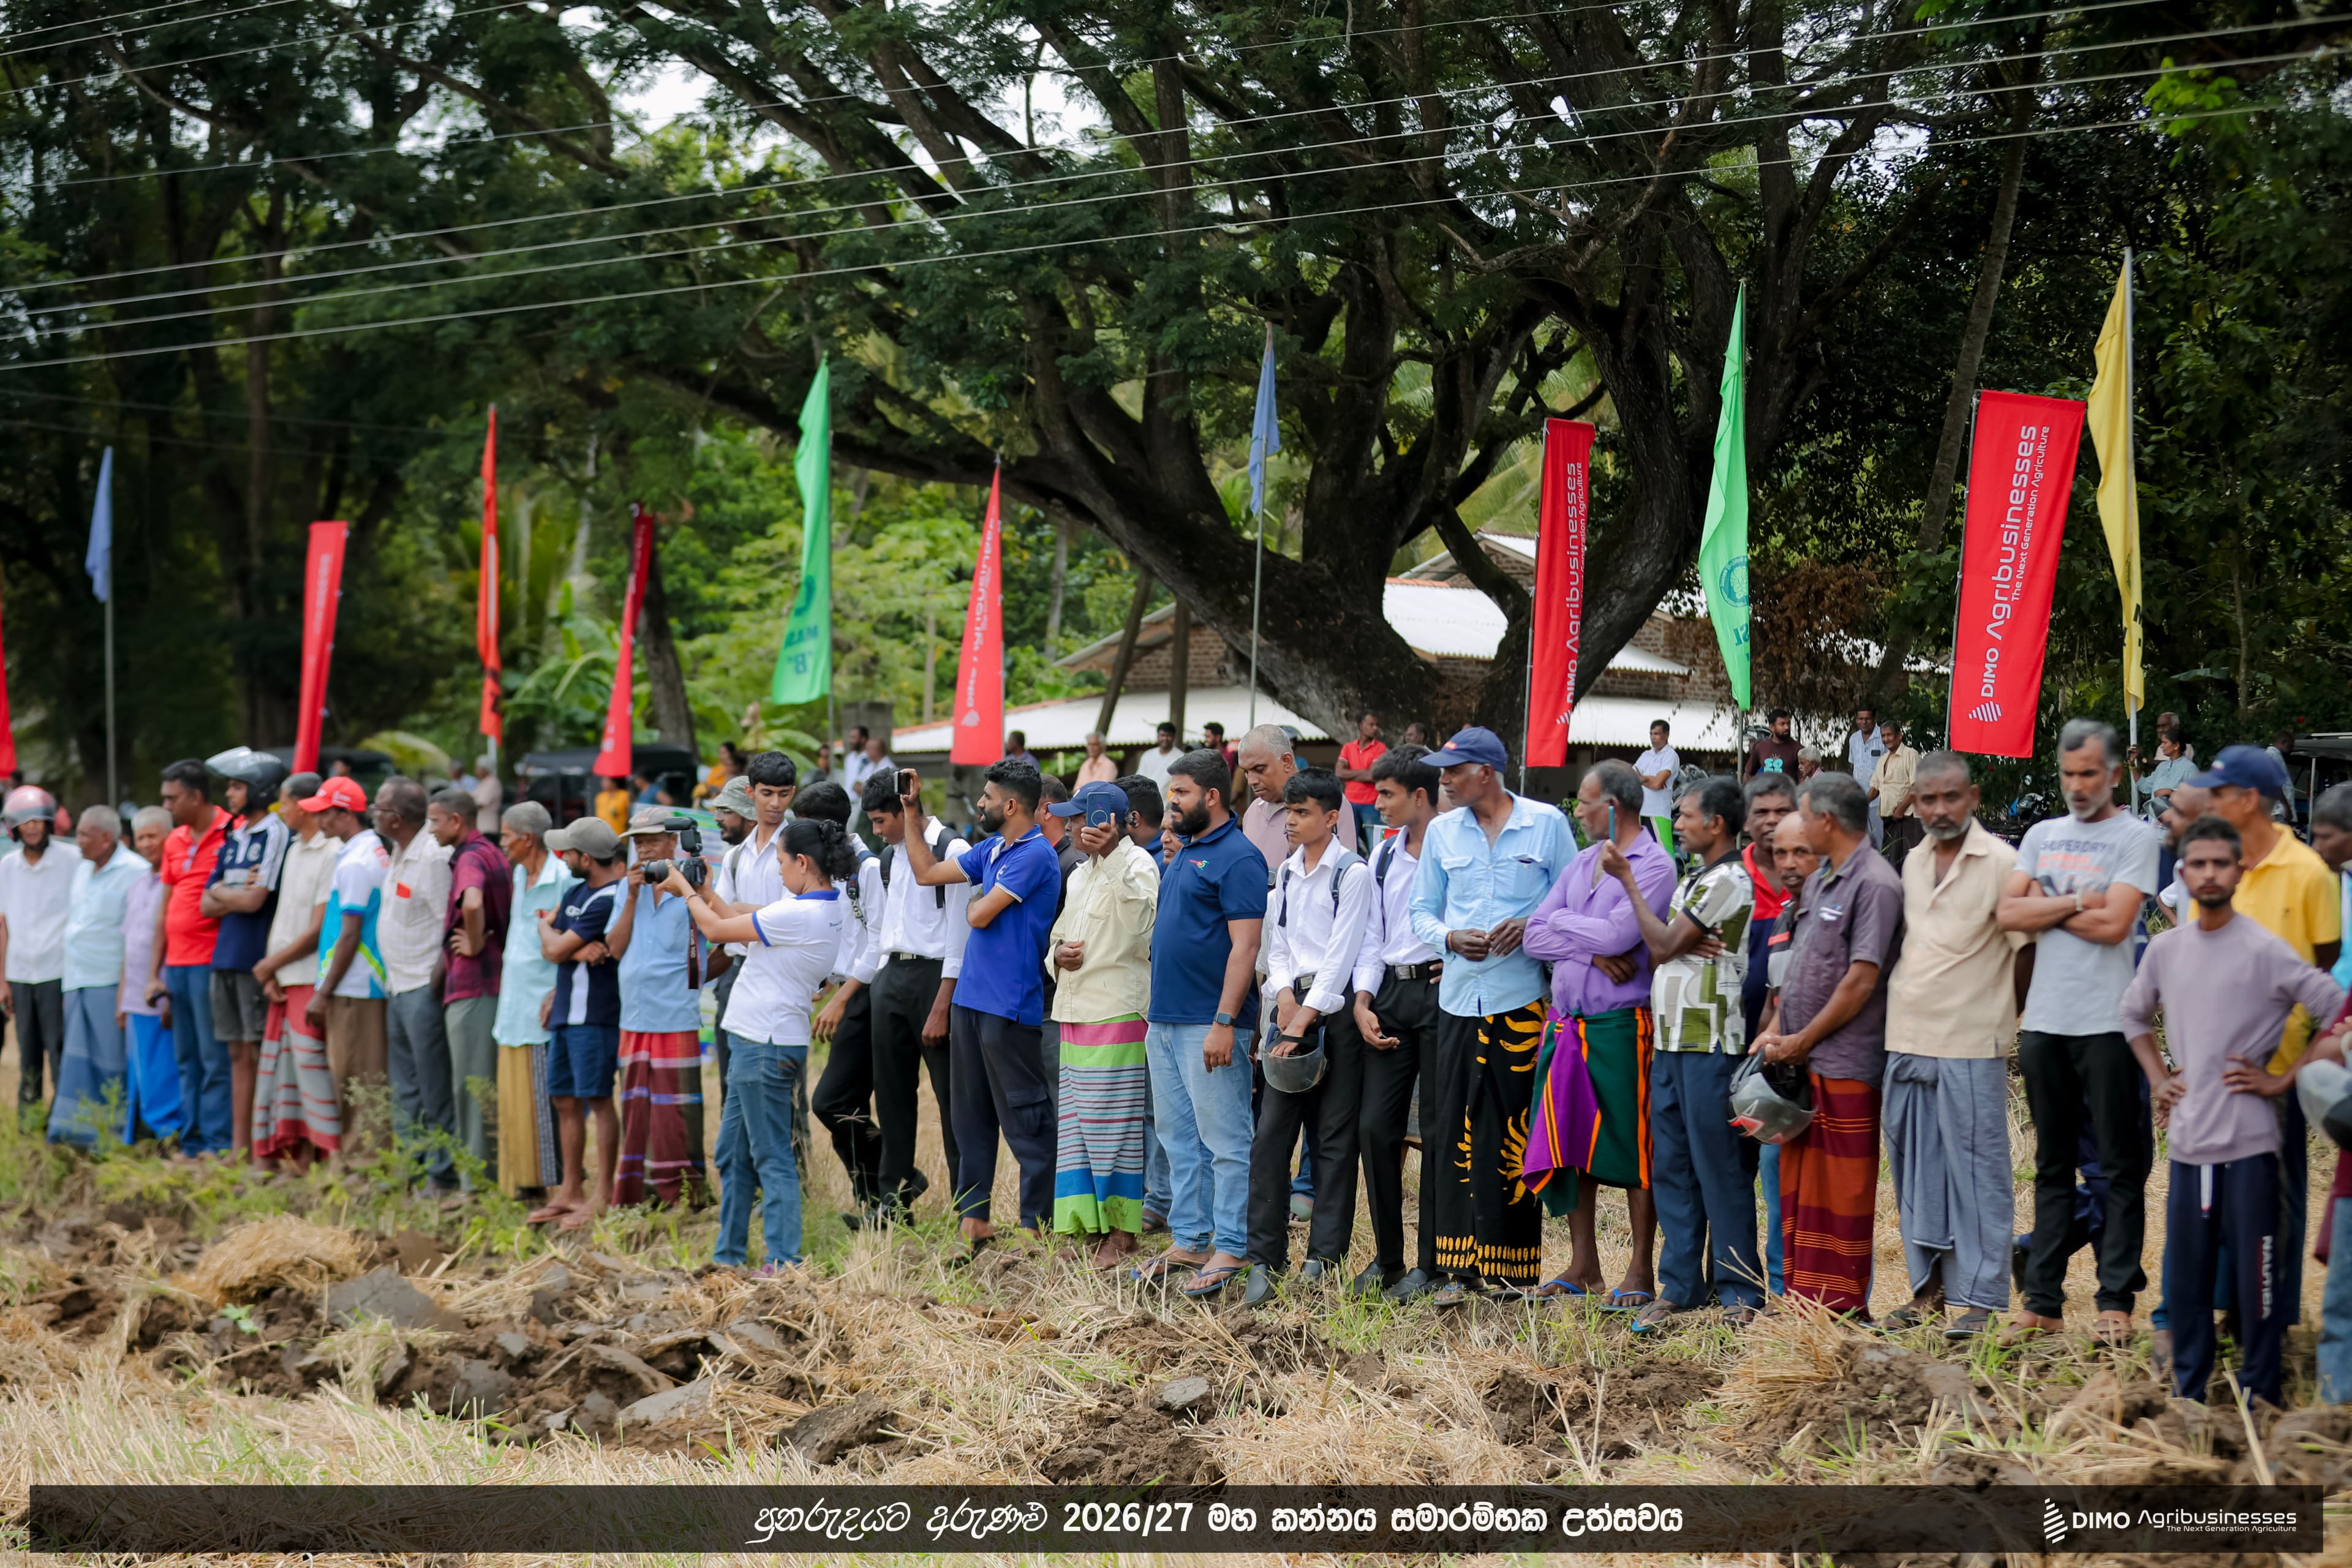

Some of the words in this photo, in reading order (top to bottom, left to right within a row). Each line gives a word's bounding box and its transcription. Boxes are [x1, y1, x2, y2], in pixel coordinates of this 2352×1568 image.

[2031, 426, 2050, 488] Agriculture
[1577, 462, 1586, 516] Agriculture
[1986, 426, 2037, 641] Agribusinesses
[2021, 489, 2038, 549] Generation
[1566, 462, 1581, 654] Agribusinesses
[2016, 551, 2028, 579] Next
[2011, 582, 2022, 601] The
[1566, 659, 1578, 703] DIMO
[1981, 647, 1999, 698] DIMO
